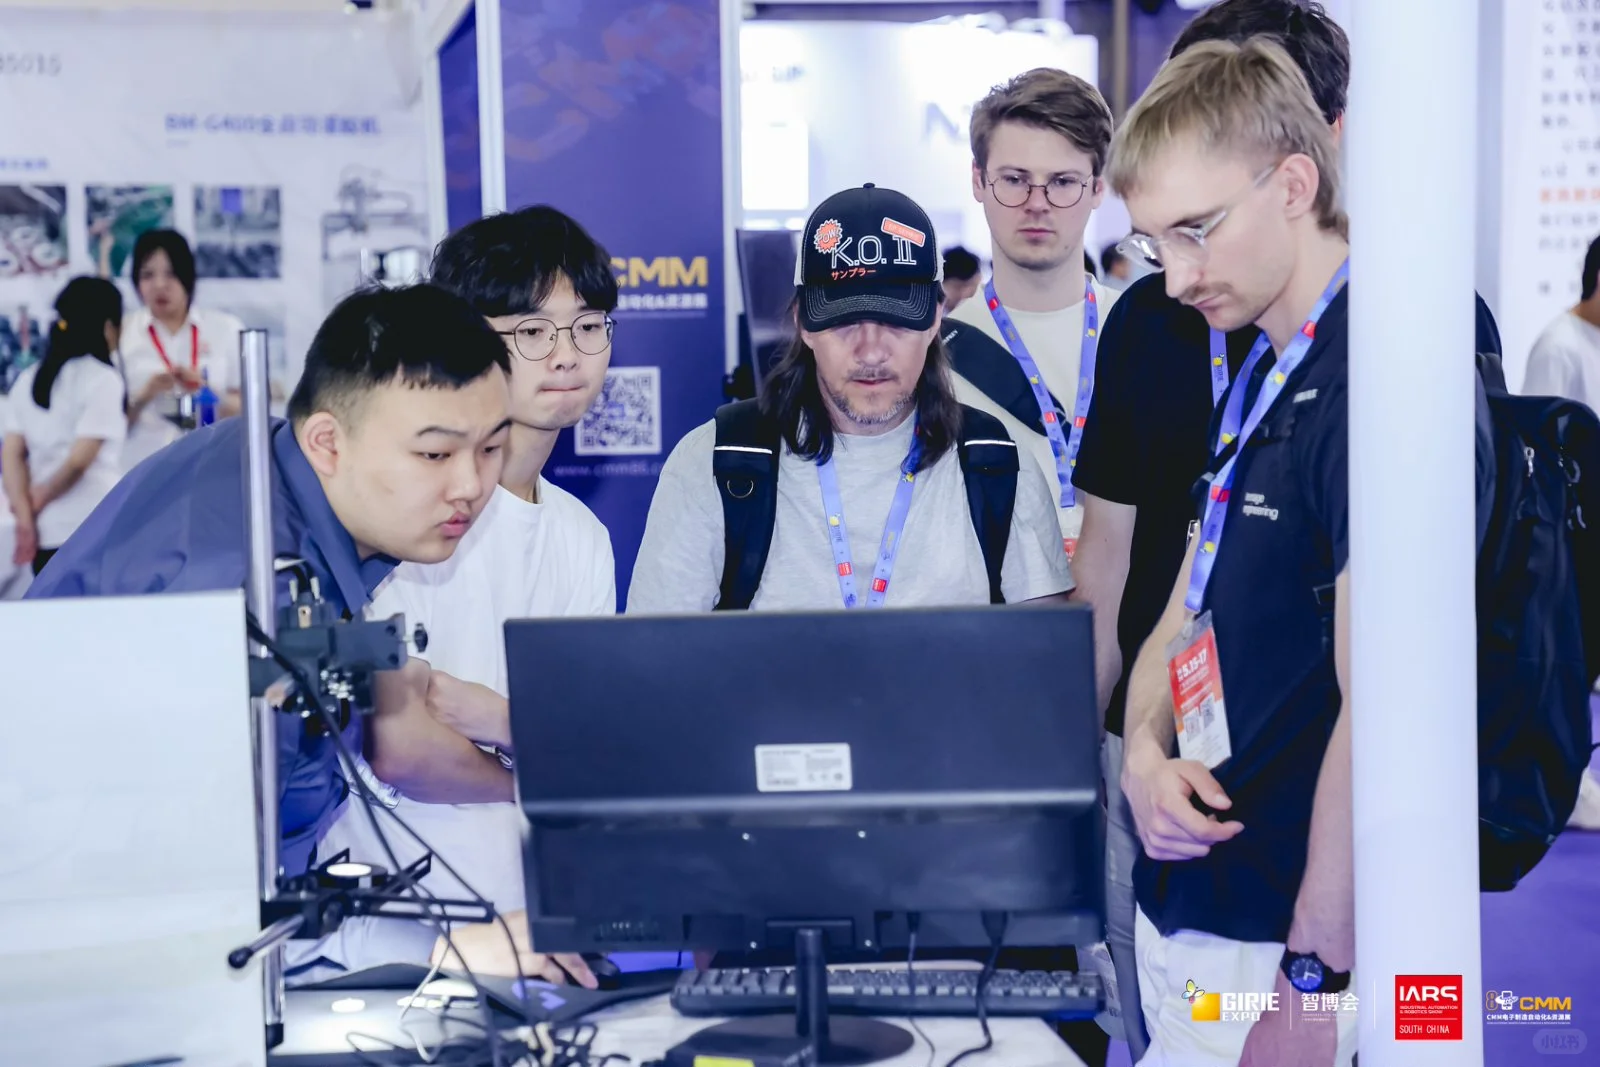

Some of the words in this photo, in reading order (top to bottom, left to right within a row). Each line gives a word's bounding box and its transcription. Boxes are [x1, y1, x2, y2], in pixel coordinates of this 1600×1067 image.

[831, 267, 877, 280] サンプラー
